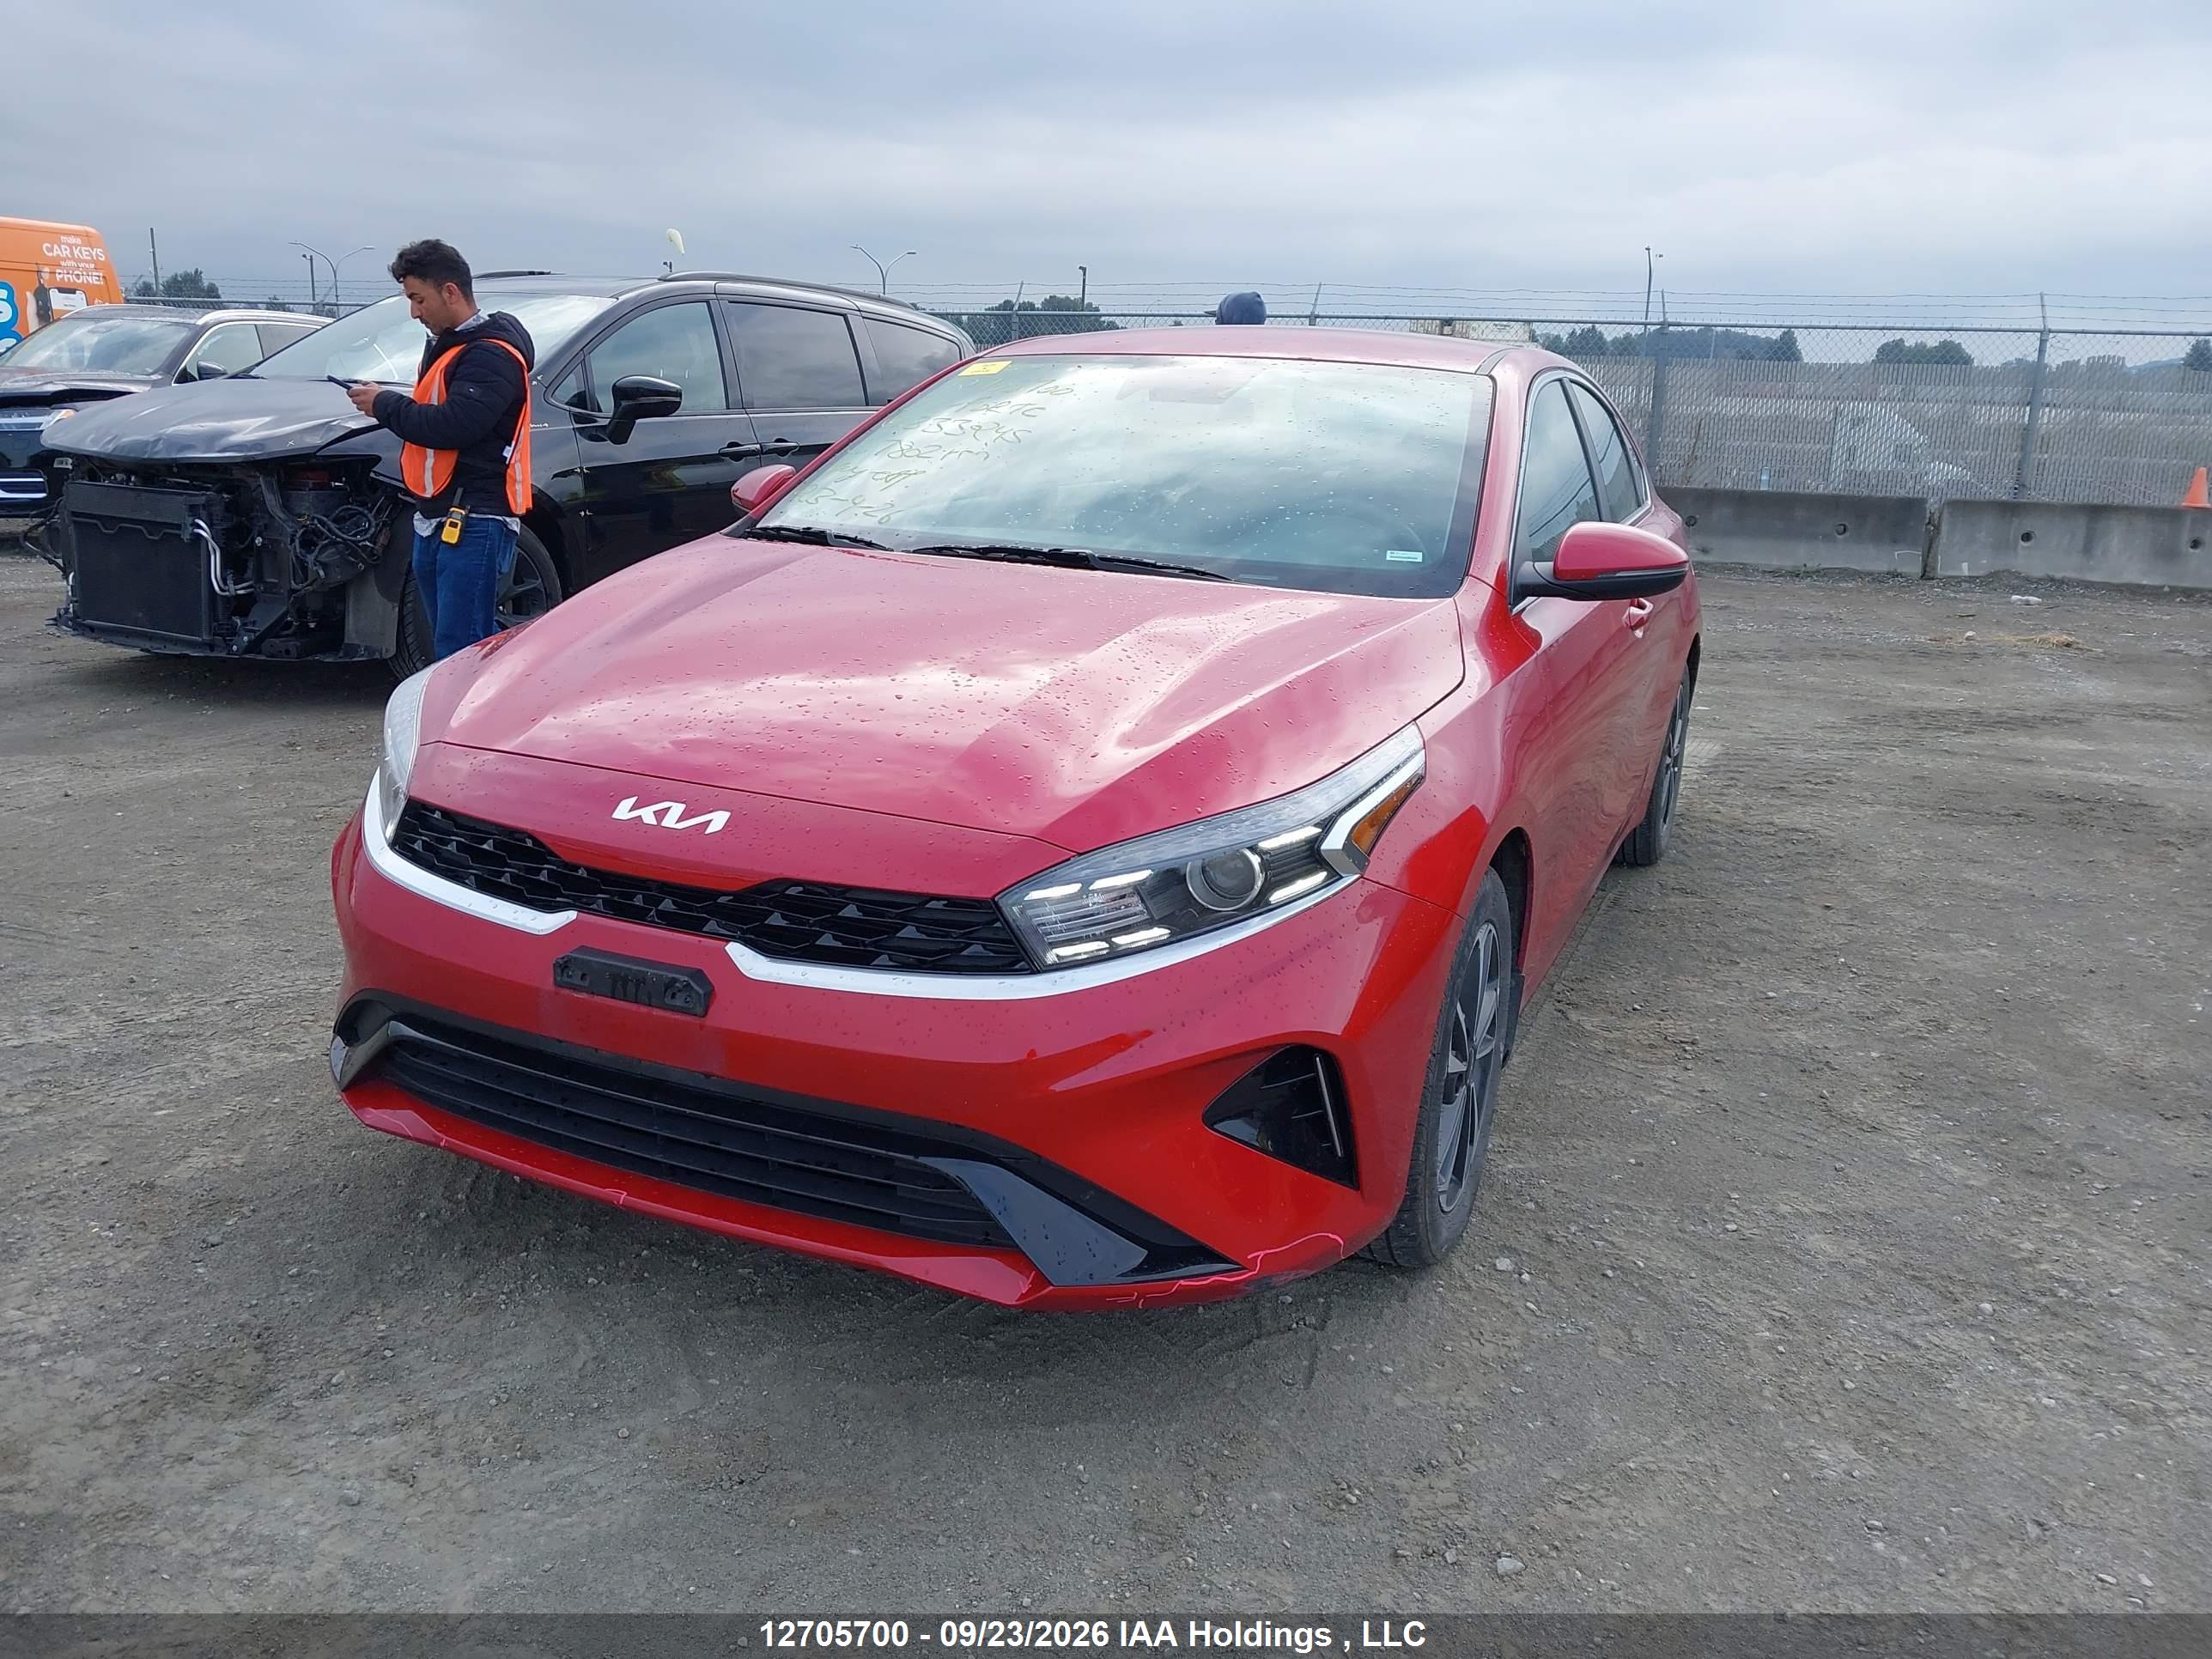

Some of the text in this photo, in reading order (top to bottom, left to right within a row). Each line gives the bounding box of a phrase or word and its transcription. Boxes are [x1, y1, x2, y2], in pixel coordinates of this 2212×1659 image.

[42, 242, 106, 261] CAR KEYS
[60, 259, 76, 268] with
[55, 269, 104, 285] PHONE!
[611, 796, 731, 835] KIA
